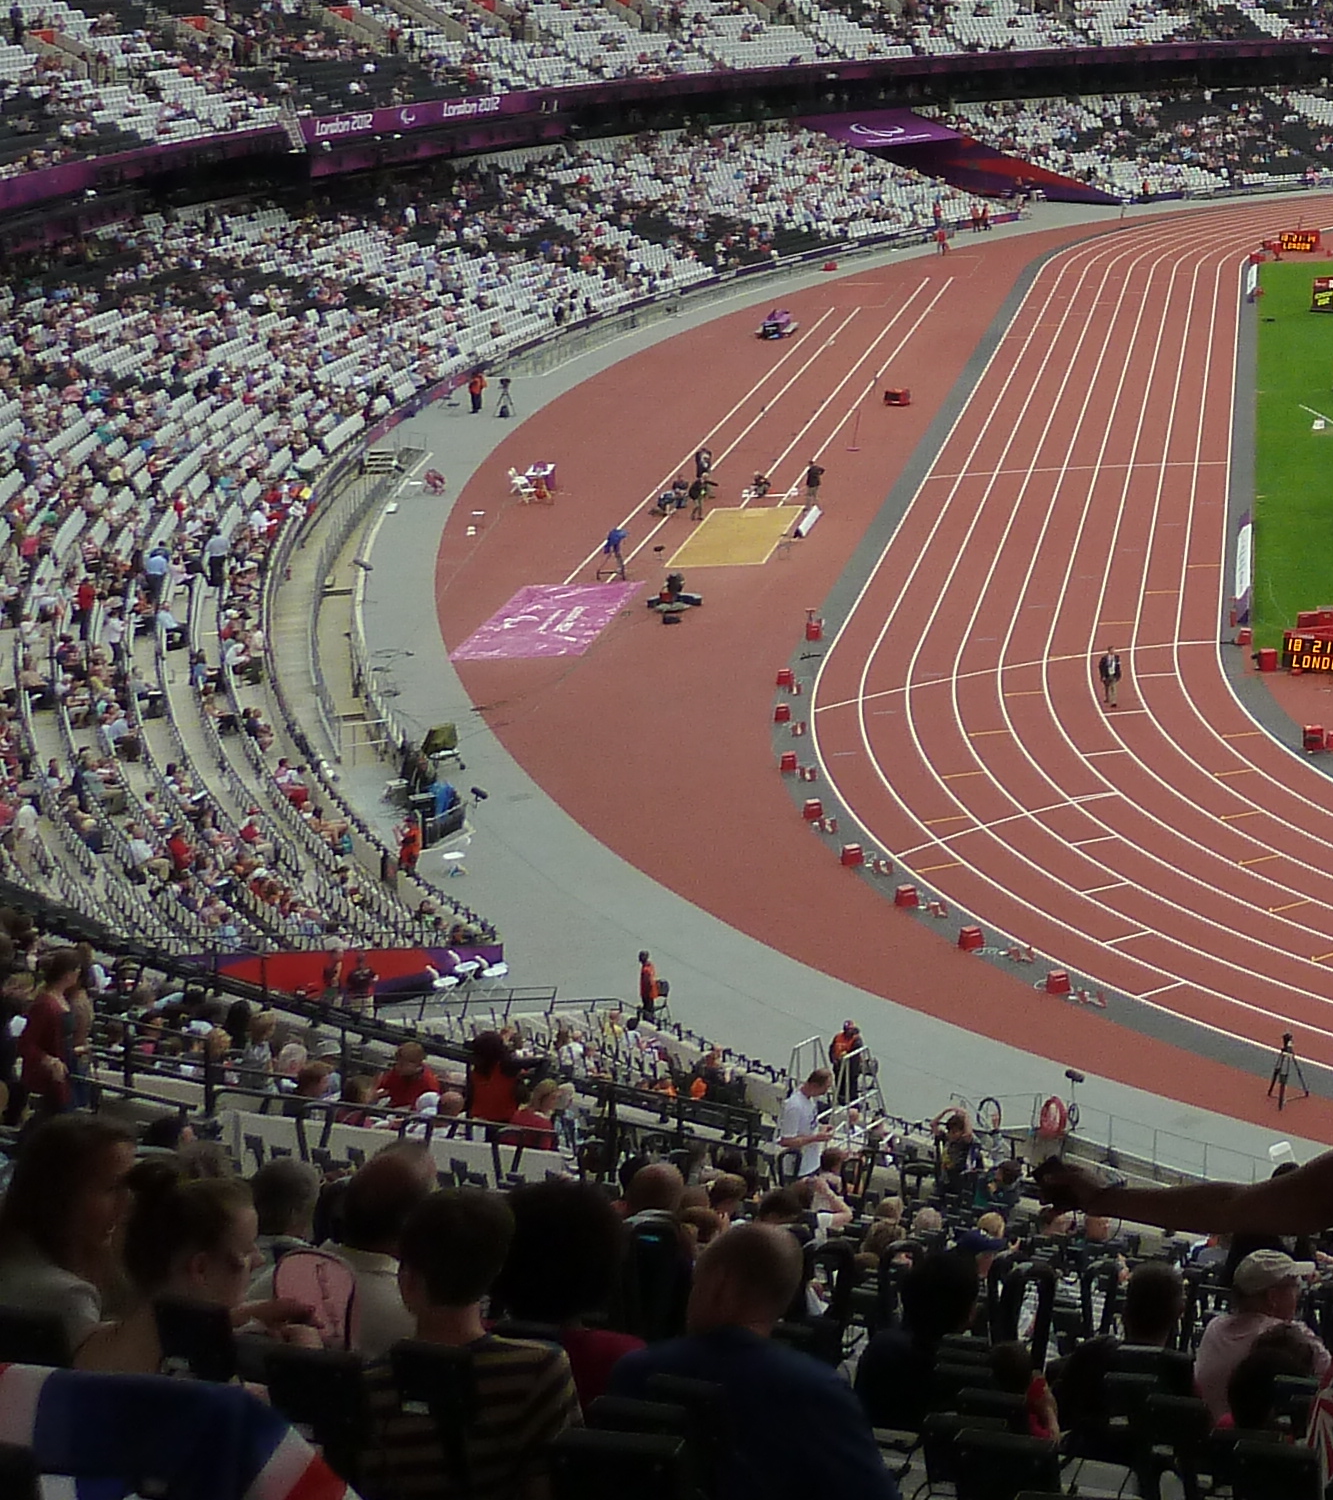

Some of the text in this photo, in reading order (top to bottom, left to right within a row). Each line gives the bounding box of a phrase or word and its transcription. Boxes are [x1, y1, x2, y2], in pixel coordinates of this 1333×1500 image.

[443, 96, 501, 117] London 2012
[315, 113, 373, 136] London 2012
